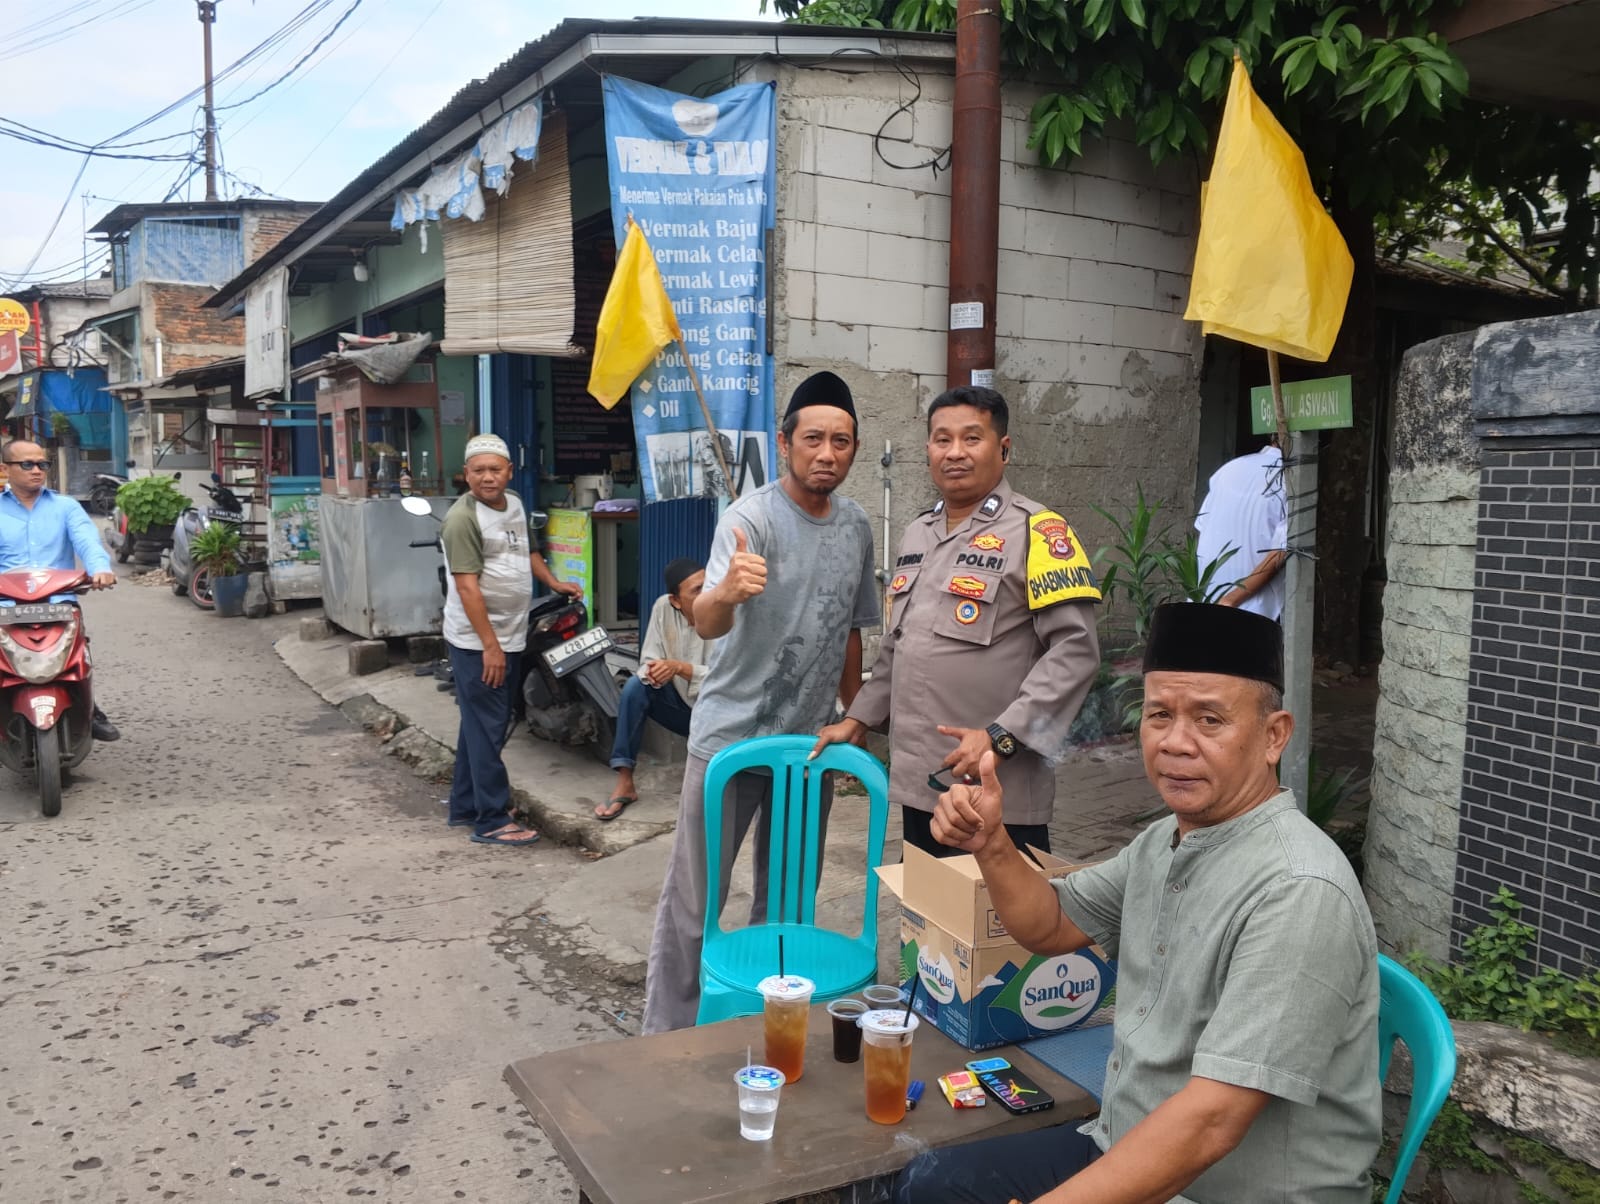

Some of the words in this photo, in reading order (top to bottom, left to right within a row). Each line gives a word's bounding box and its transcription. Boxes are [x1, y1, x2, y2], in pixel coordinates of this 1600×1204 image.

[660, 186, 692, 205] Vermak
[694, 187, 727, 206] Pakaian
[728, 188, 745, 205] Pria
[640, 218, 710, 238] Vermak
[716, 219, 758, 241] Baju
[661, 271, 714, 289] ermak
[672, 296, 693, 315] nti
[1299, 390, 1339, 418] ASWANI
[956, 553, 1004, 570] POLRI
[919, 956, 954, 989] SanQua
[1024, 979, 1096, 1006] SanQua
